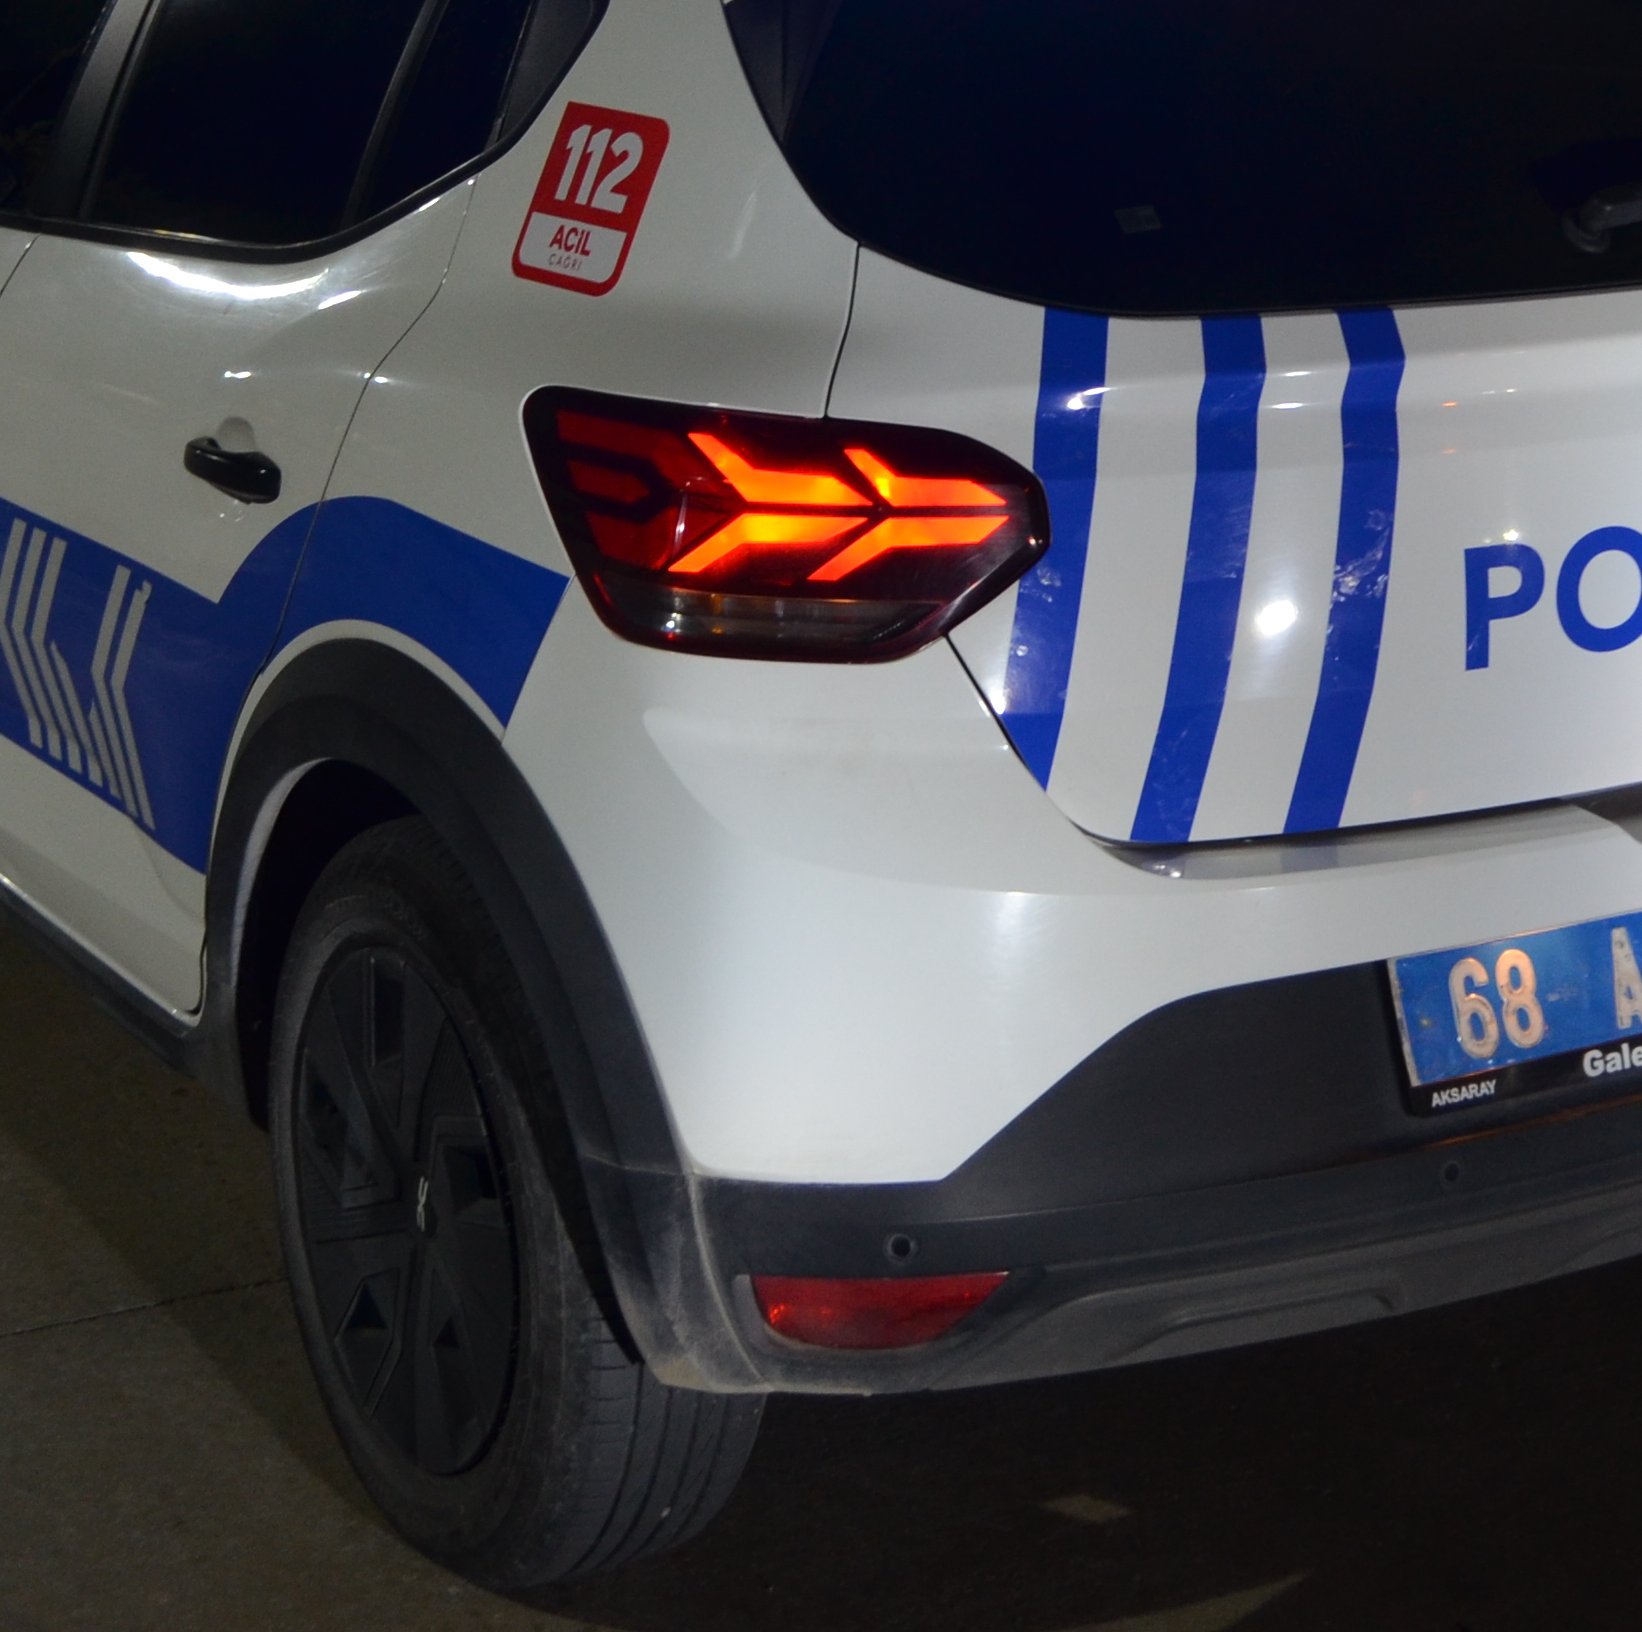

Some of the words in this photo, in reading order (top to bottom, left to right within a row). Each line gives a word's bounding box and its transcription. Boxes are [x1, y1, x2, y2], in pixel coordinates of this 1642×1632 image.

[554, 124, 644, 214] 112
[1448, 948, 1545, 1059] 68
[1431, 1079, 1498, 1109] AKSARAY
